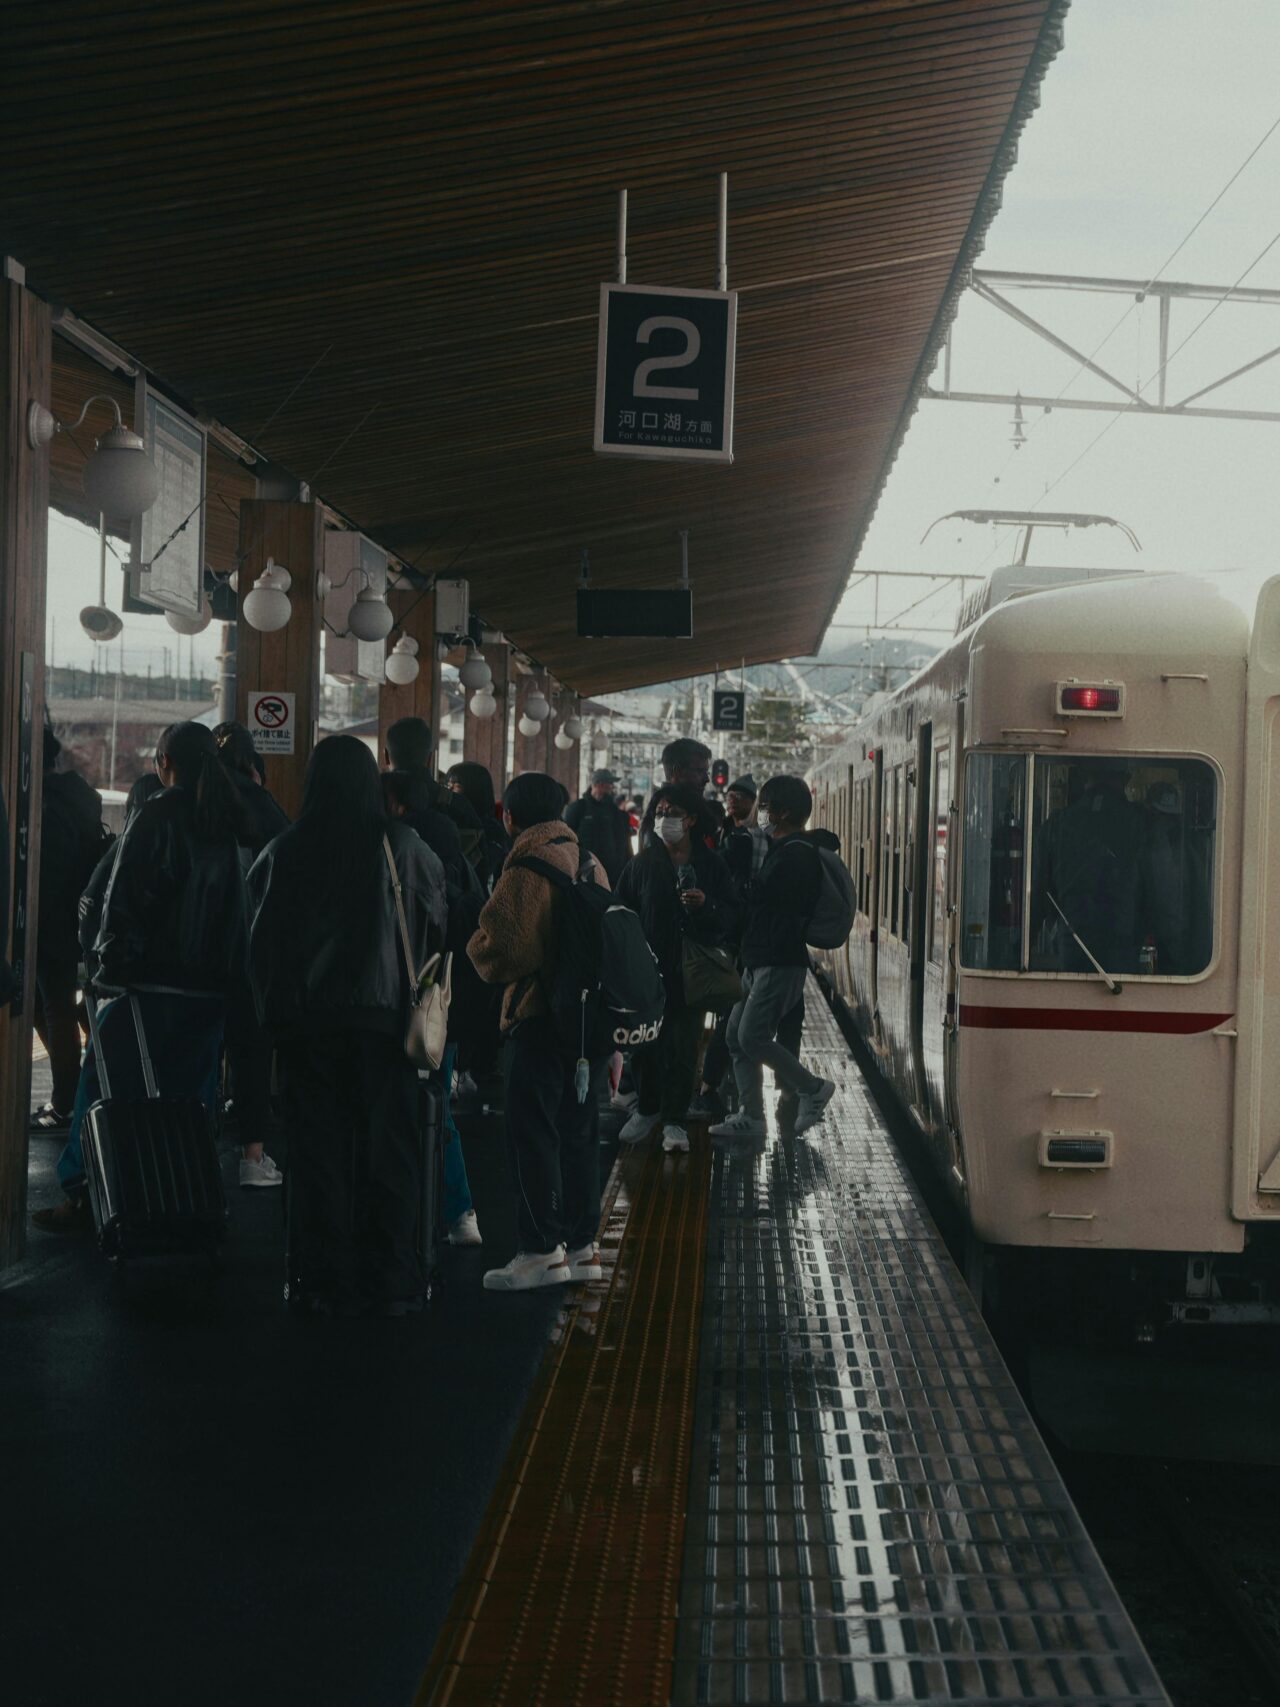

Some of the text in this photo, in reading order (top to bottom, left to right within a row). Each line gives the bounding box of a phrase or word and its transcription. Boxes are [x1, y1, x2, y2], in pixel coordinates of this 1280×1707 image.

[633, 315, 701, 400] 2
[618, 431, 634, 441] For
[719, 696, 738, 719] 2
